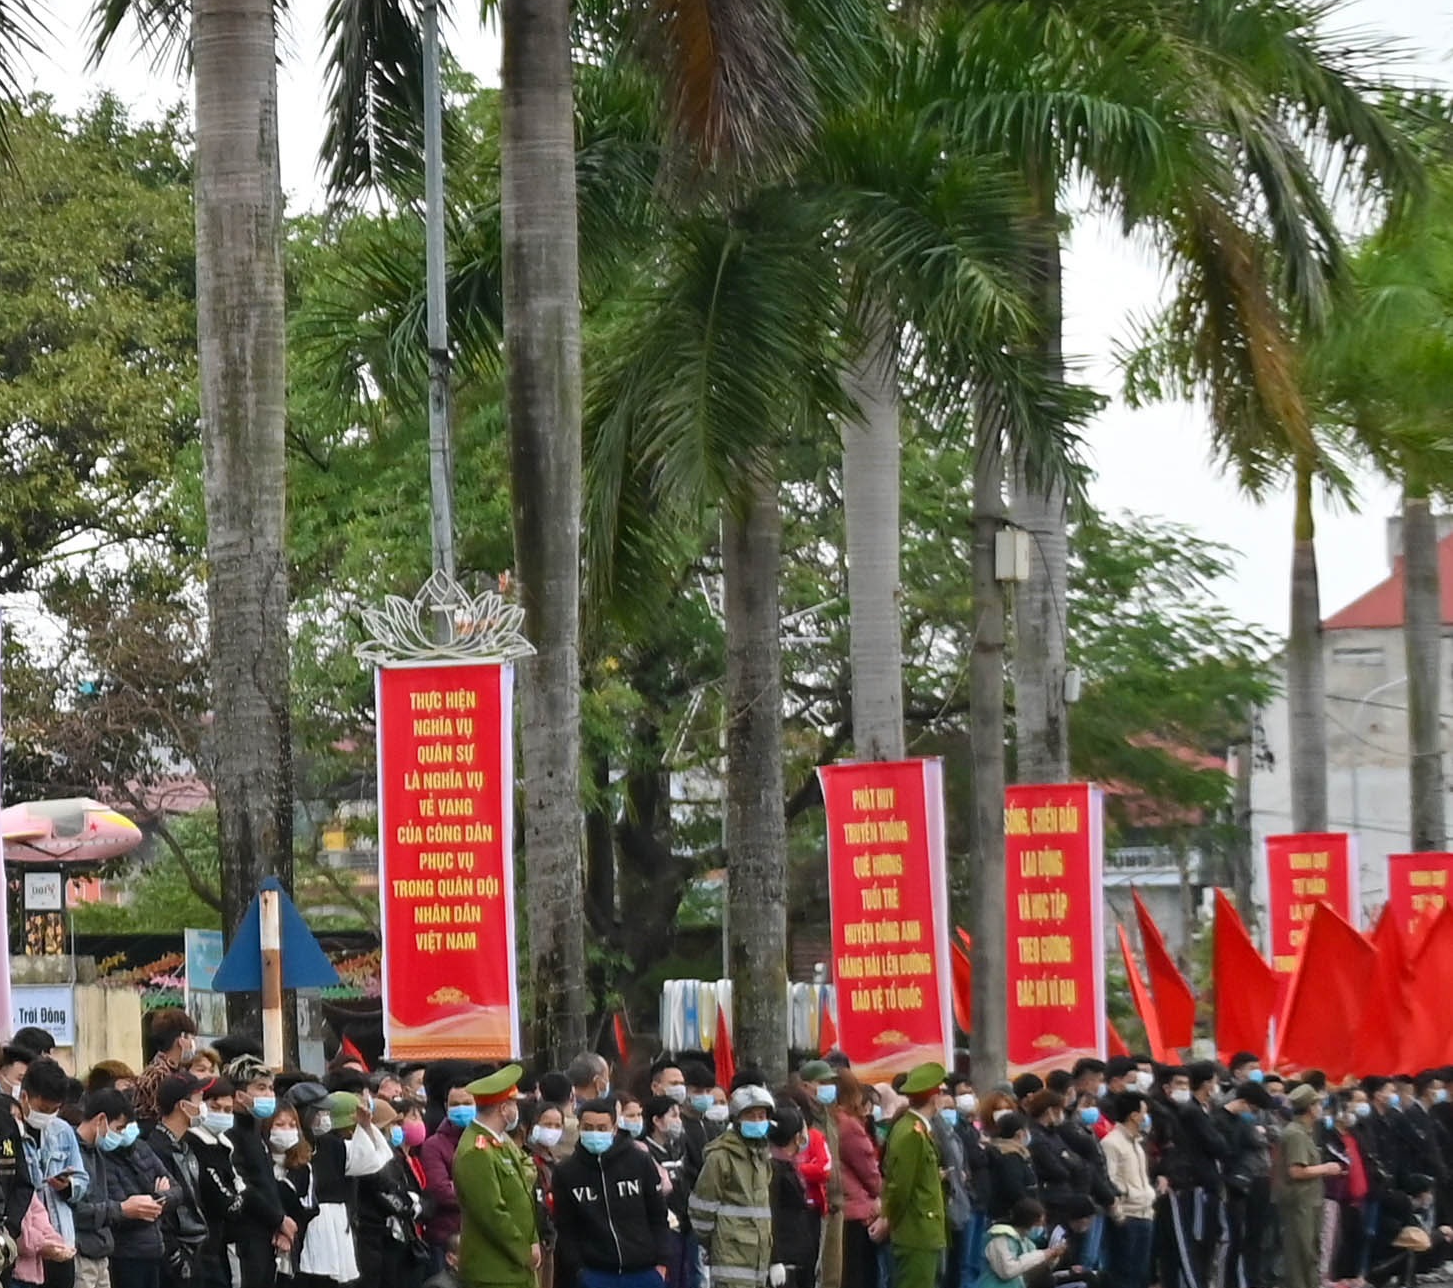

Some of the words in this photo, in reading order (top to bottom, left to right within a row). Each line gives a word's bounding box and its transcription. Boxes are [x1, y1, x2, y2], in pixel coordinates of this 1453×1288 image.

[409, 690, 442, 712] THỰC
[445, 687, 476, 713] HIỆN
[413, 717, 452, 737] NGHĨA
[455, 718, 473, 740] VỤ
[417, 741, 453, 765] QUÂN
[456, 744, 476, 766] SỰ
[404, 770, 420, 791] LÀ
[423, 769, 463, 790] NGHĨA
[465, 771, 484, 792] VỤ
[419, 791, 435, 817] VẺ
[438, 799, 473, 816] VANG
[397, 819, 423, 844] CỦA
[425, 822, 462, 844] CÔNG
[465, 822, 492, 842] DÂN
[419, 852, 454, 872] PHỤC
[457, 852, 474, 873] VỤ
[392, 880, 435, 898] TRONG
[437, 876, 474, 899] QUÂN
[476, 876, 499, 899] ĐỘI
[414, 902, 451, 924] NHÂN
[453, 902, 481, 924] DÂN
[415, 928, 443, 955] VIỆT
[446, 932, 477, 950] NAM
